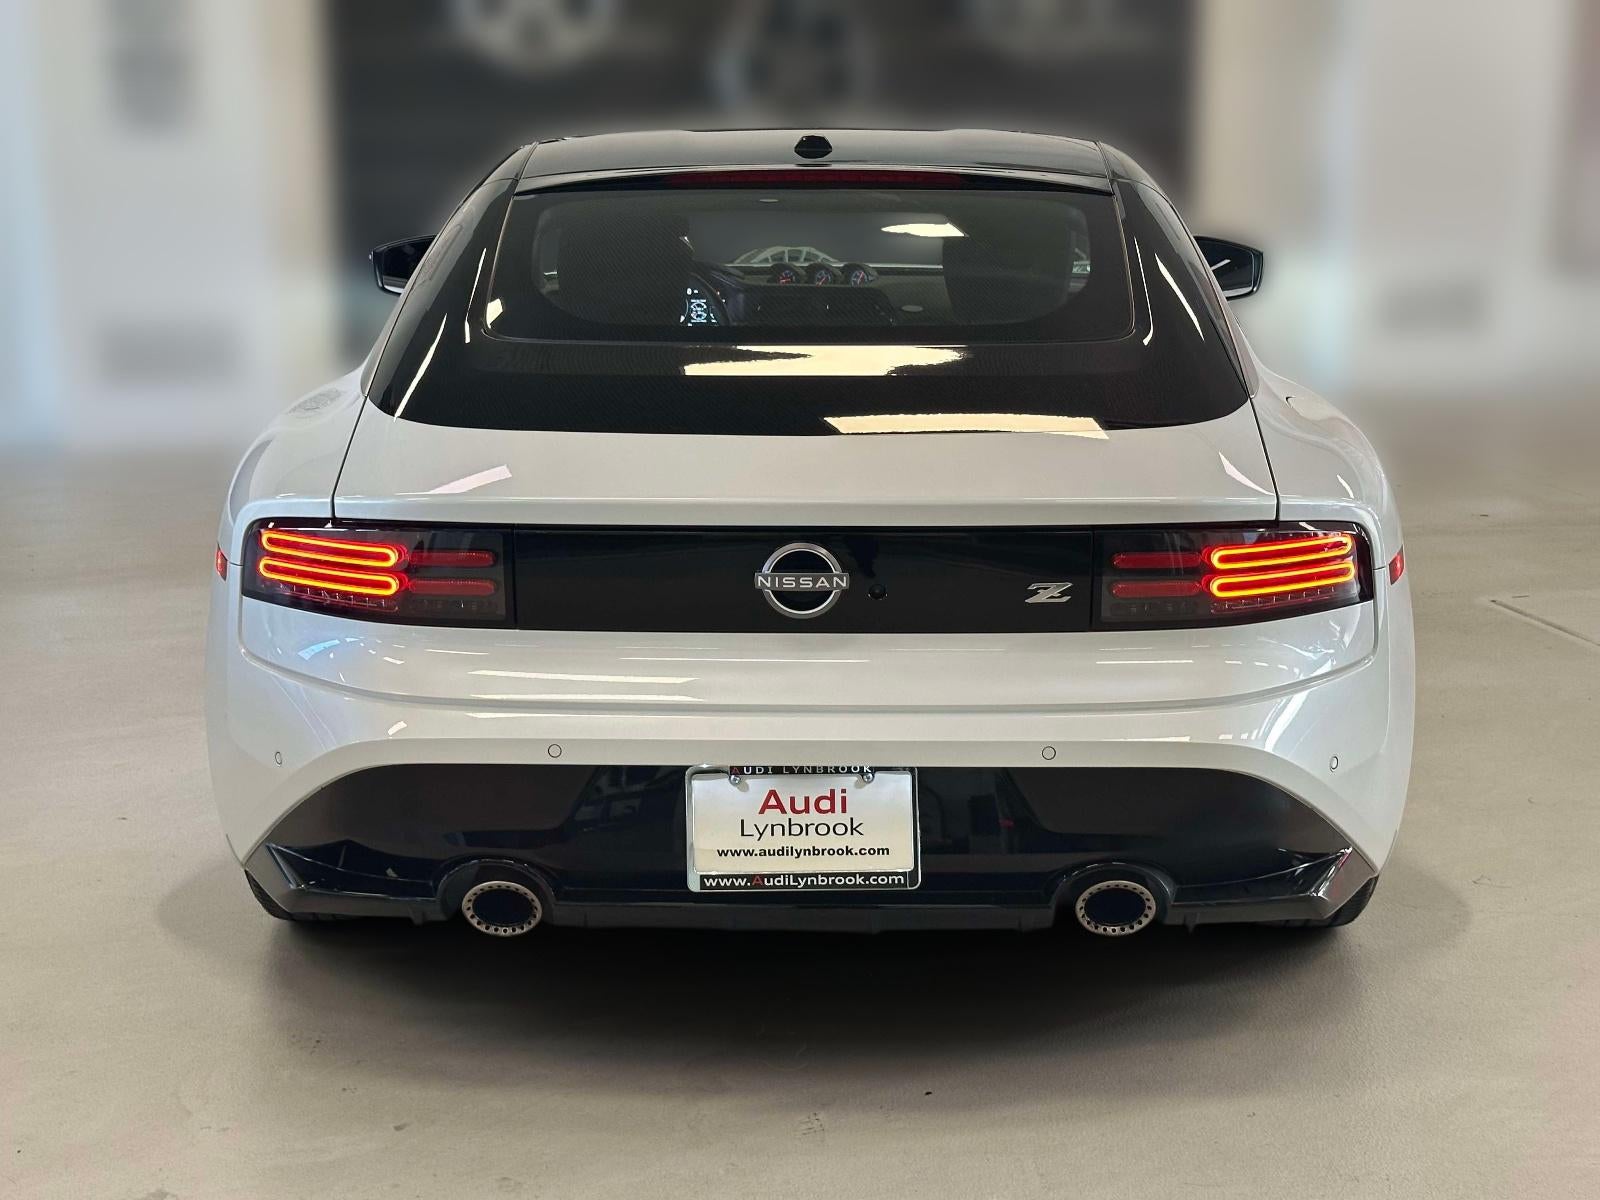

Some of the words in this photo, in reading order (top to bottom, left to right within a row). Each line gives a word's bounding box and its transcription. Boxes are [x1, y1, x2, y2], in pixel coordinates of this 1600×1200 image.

[758, 576, 847, 588] NISSAN
[1024, 582, 1073, 603] Z
[731, 766, 773, 775] AUDI
[783, 765, 872, 774] LYNBROOK
[758, 788, 847, 815] Audi
[740, 817, 864, 841] Lynbrook
[717, 845, 890, 859] www.audilynbrook.com
[703, 873, 905, 889] www.AudiLynbrook.com
